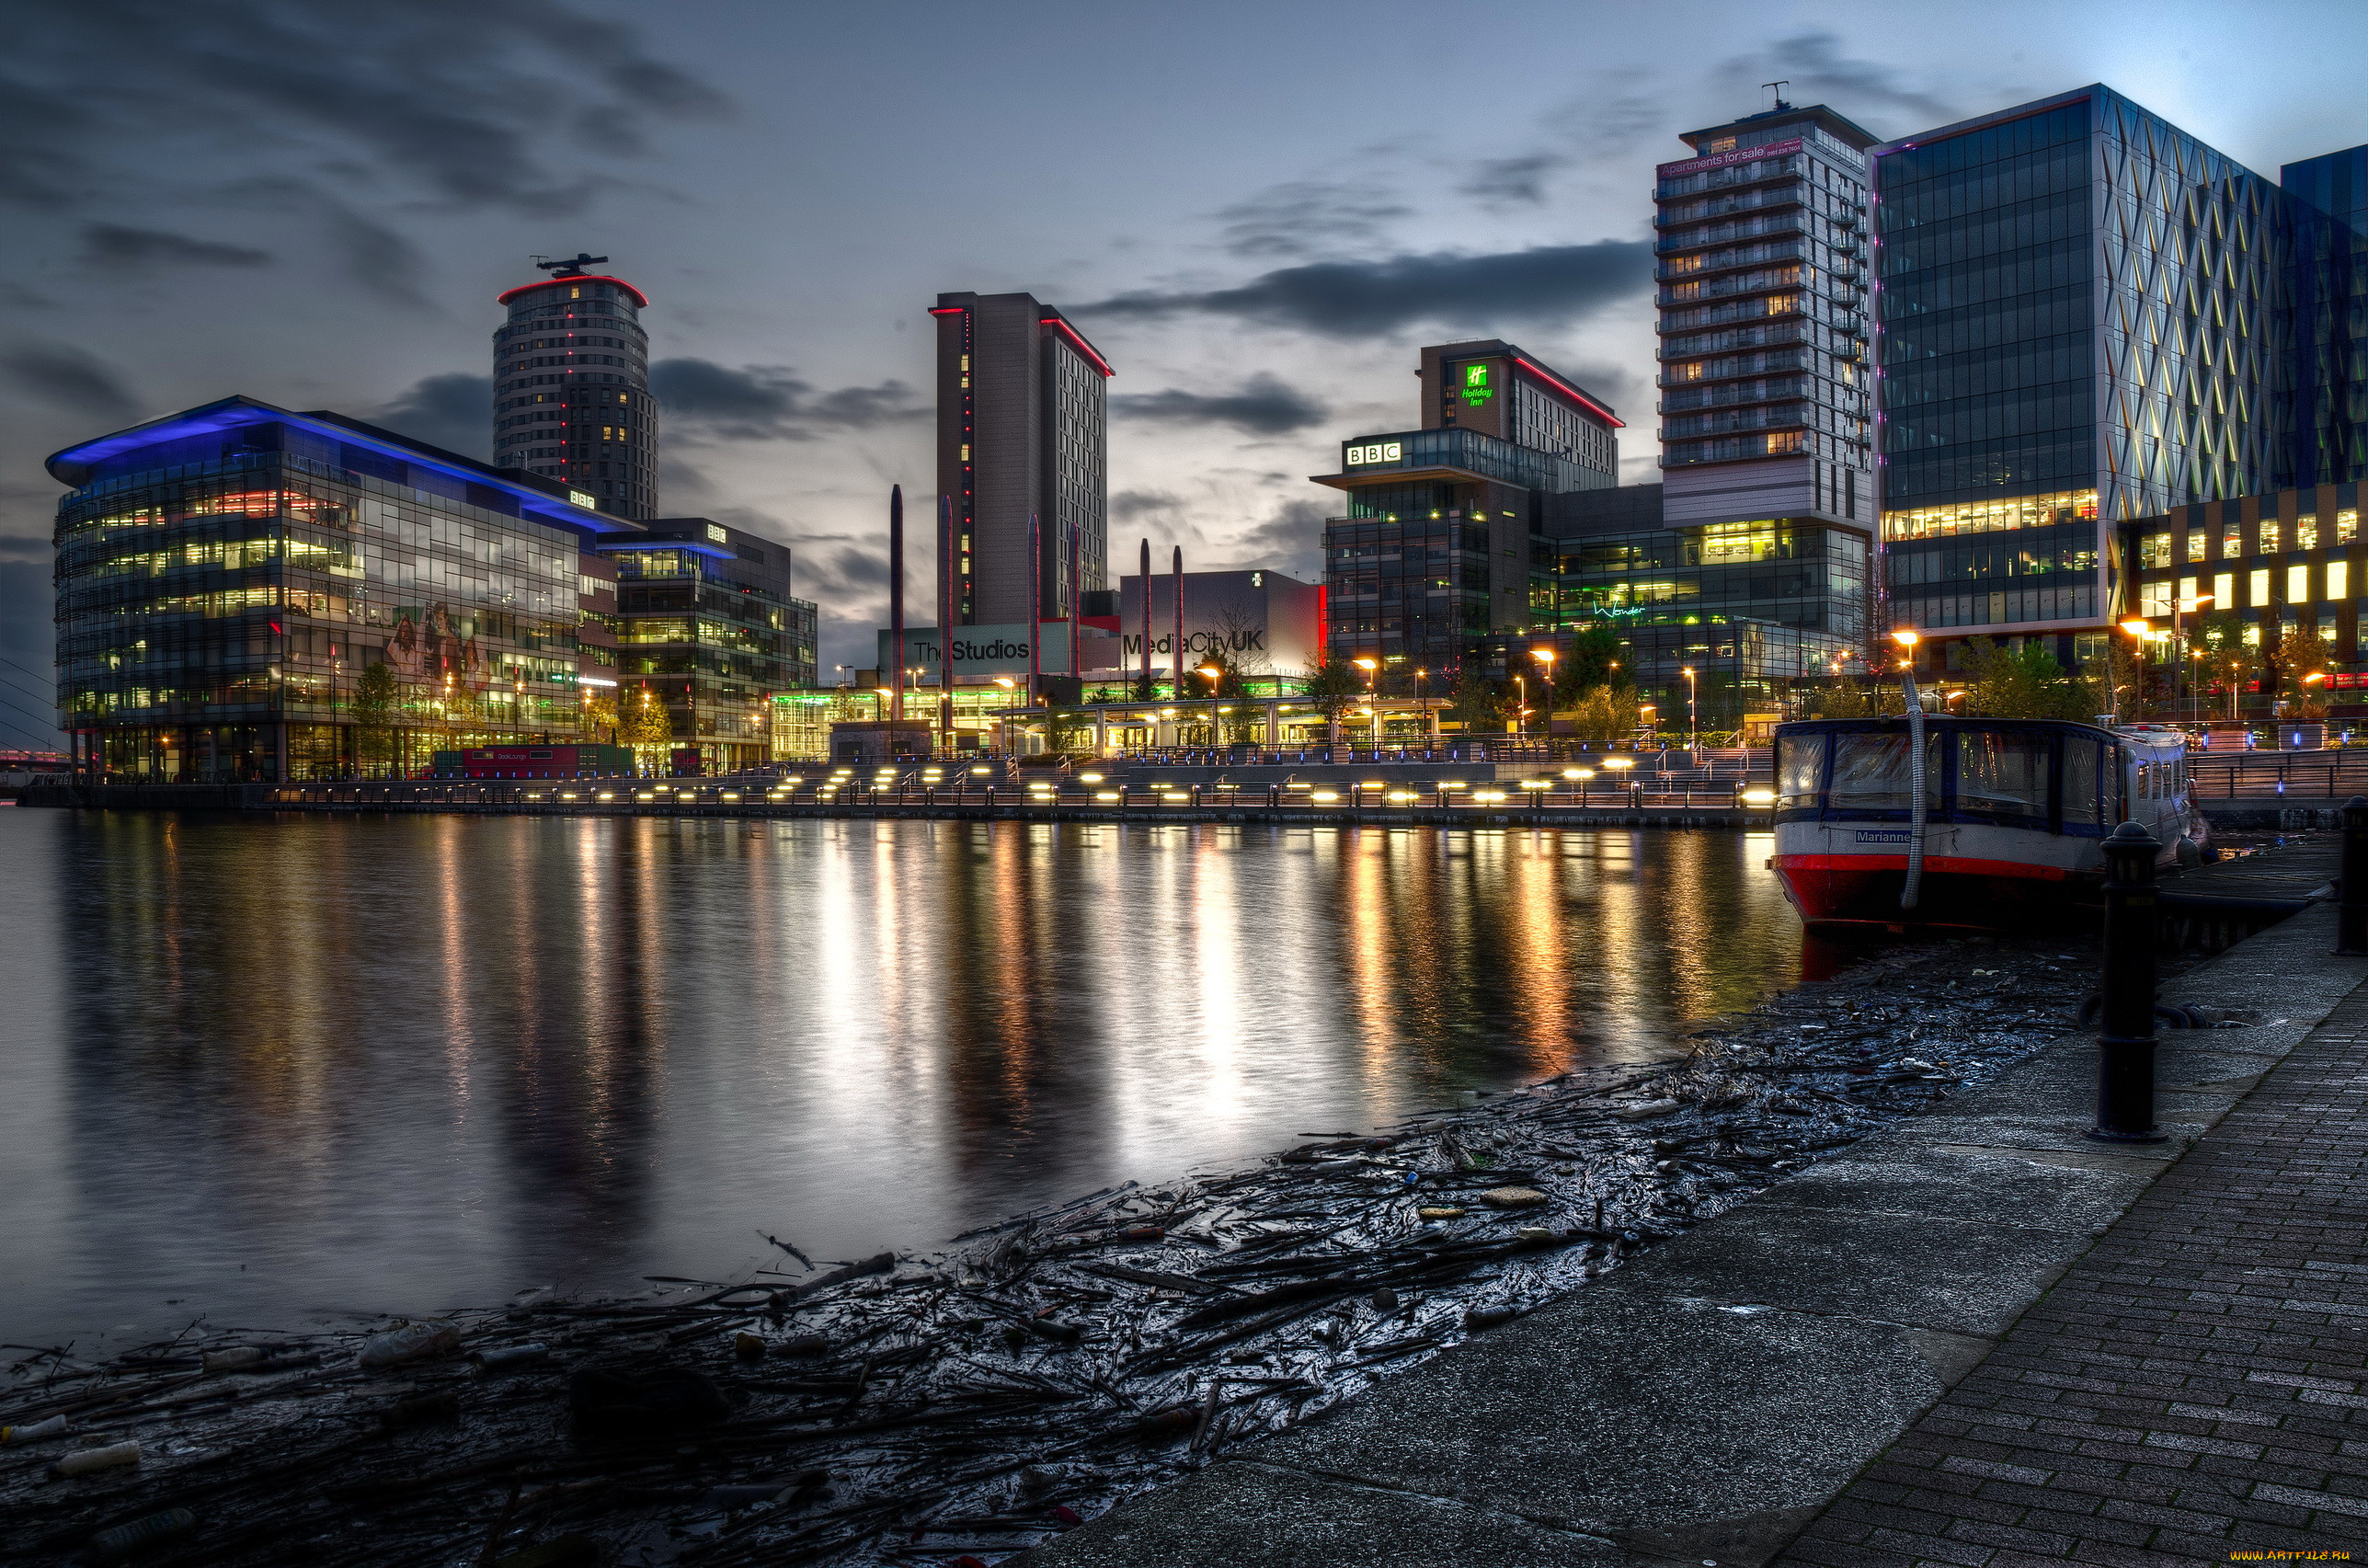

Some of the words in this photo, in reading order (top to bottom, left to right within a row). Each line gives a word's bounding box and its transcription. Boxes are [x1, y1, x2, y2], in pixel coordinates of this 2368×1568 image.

[1662, 155, 1722, 176] Apartments
[1724, 152, 1740, 164] for
[1741, 146, 1765, 160] sale
[1461, 387, 1493, 398] Holiday
[1470, 397, 1484, 406] Inn
[1350, 444, 1399, 464] BBC
[708, 525, 726, 542] BBC
[1593, 600, 1645, 618] Wonder
[952, 639, 1029, 660] Studios
[1857, 830, 1912, 842] Marianne
